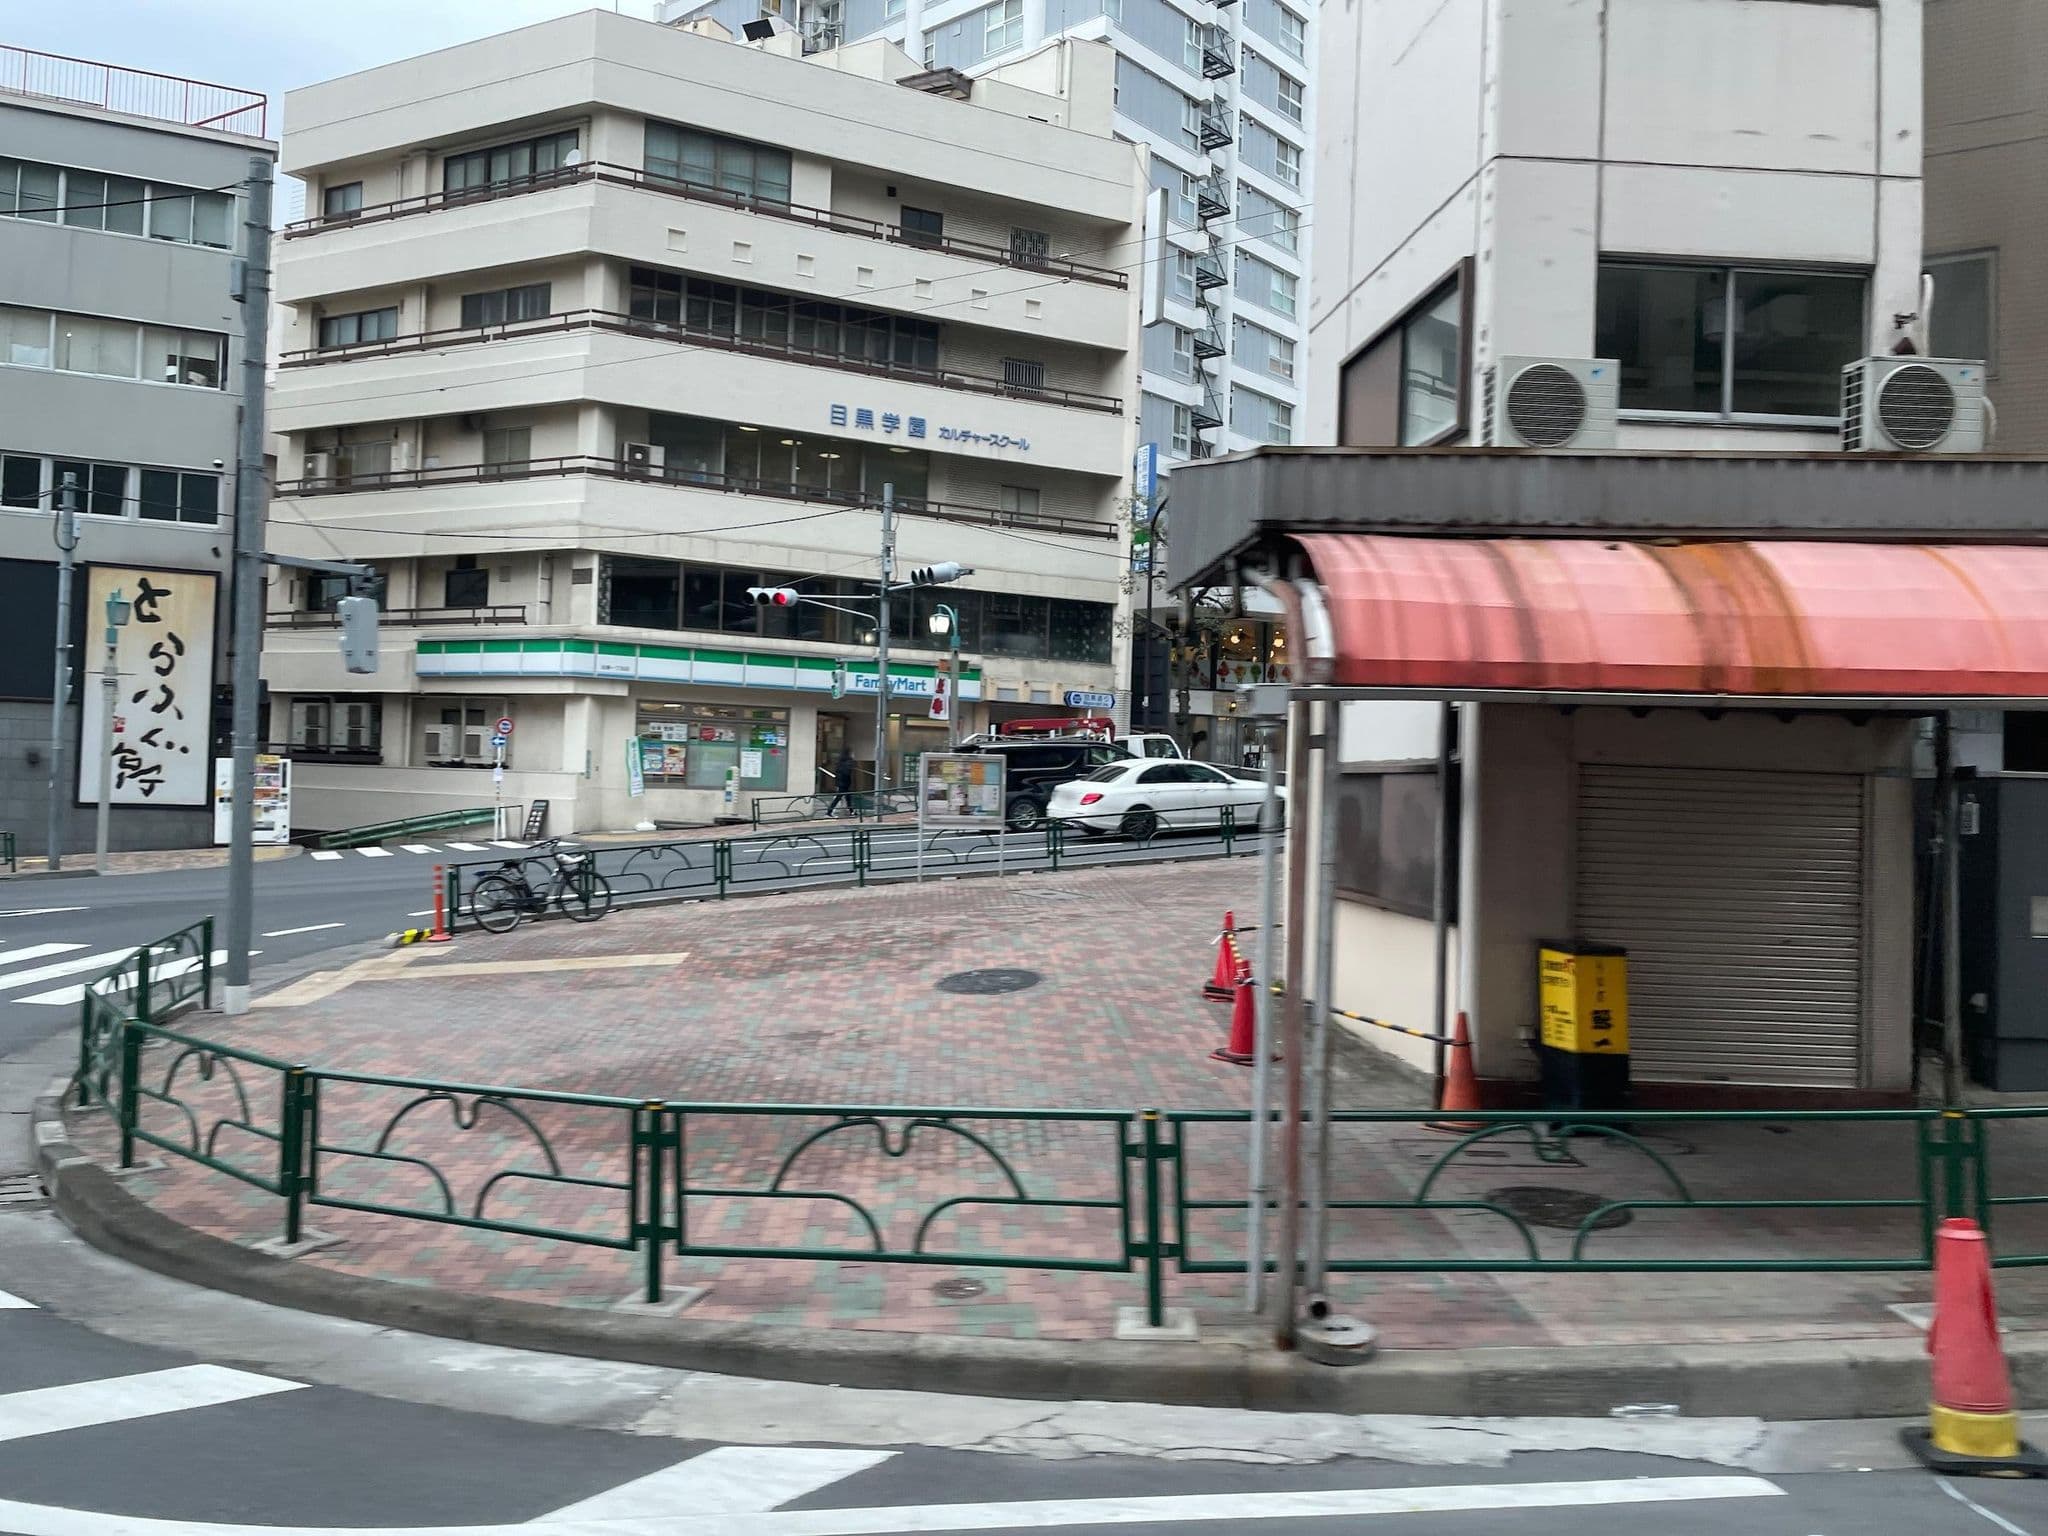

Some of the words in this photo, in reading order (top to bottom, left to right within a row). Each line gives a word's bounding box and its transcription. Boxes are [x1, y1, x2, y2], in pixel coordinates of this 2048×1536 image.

[830, 403, 927, 439] 目黒学園
[938, 426, 1031, 451] カルチャースクール
[111, 577, 190, 797] とらふぐ亭
[855, 674, 928, 692] FamyMart
